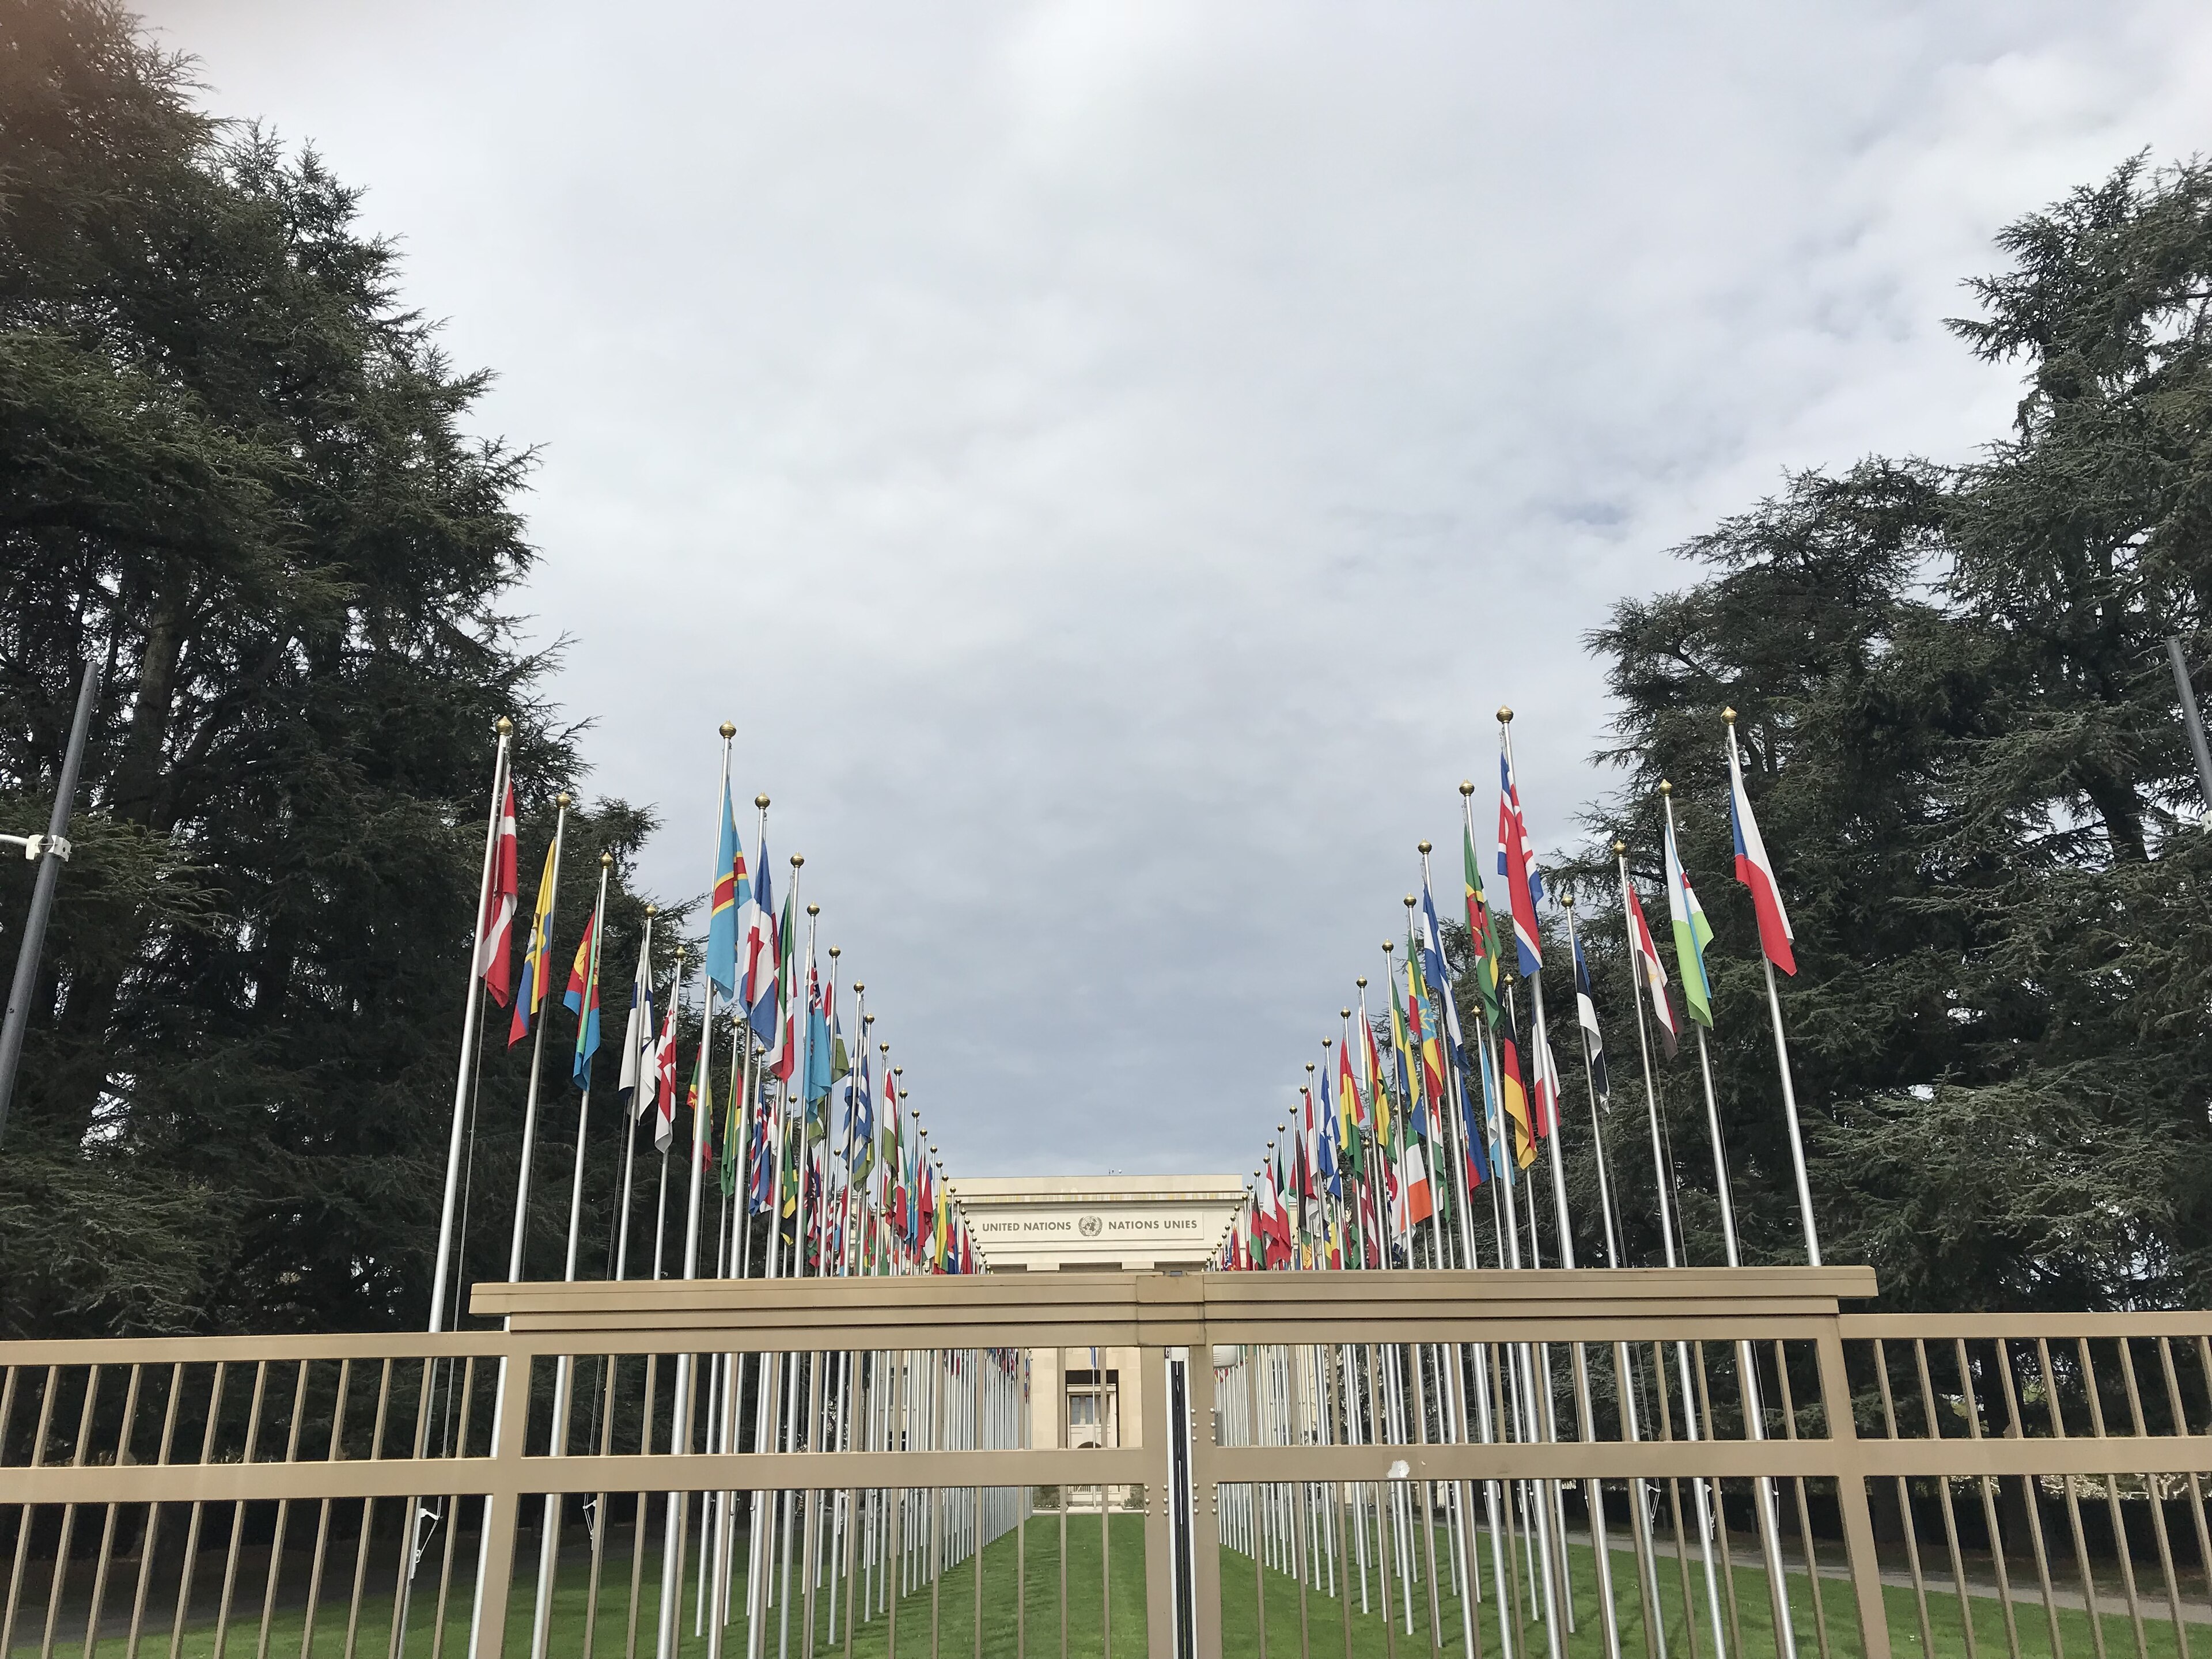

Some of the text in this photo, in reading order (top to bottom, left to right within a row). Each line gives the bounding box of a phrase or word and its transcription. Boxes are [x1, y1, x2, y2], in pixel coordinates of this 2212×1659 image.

[982, 1221, 1071, 1232] UNITED NATIONS
[1108, 1220, 1197, 1230] NATIONS UNIES
